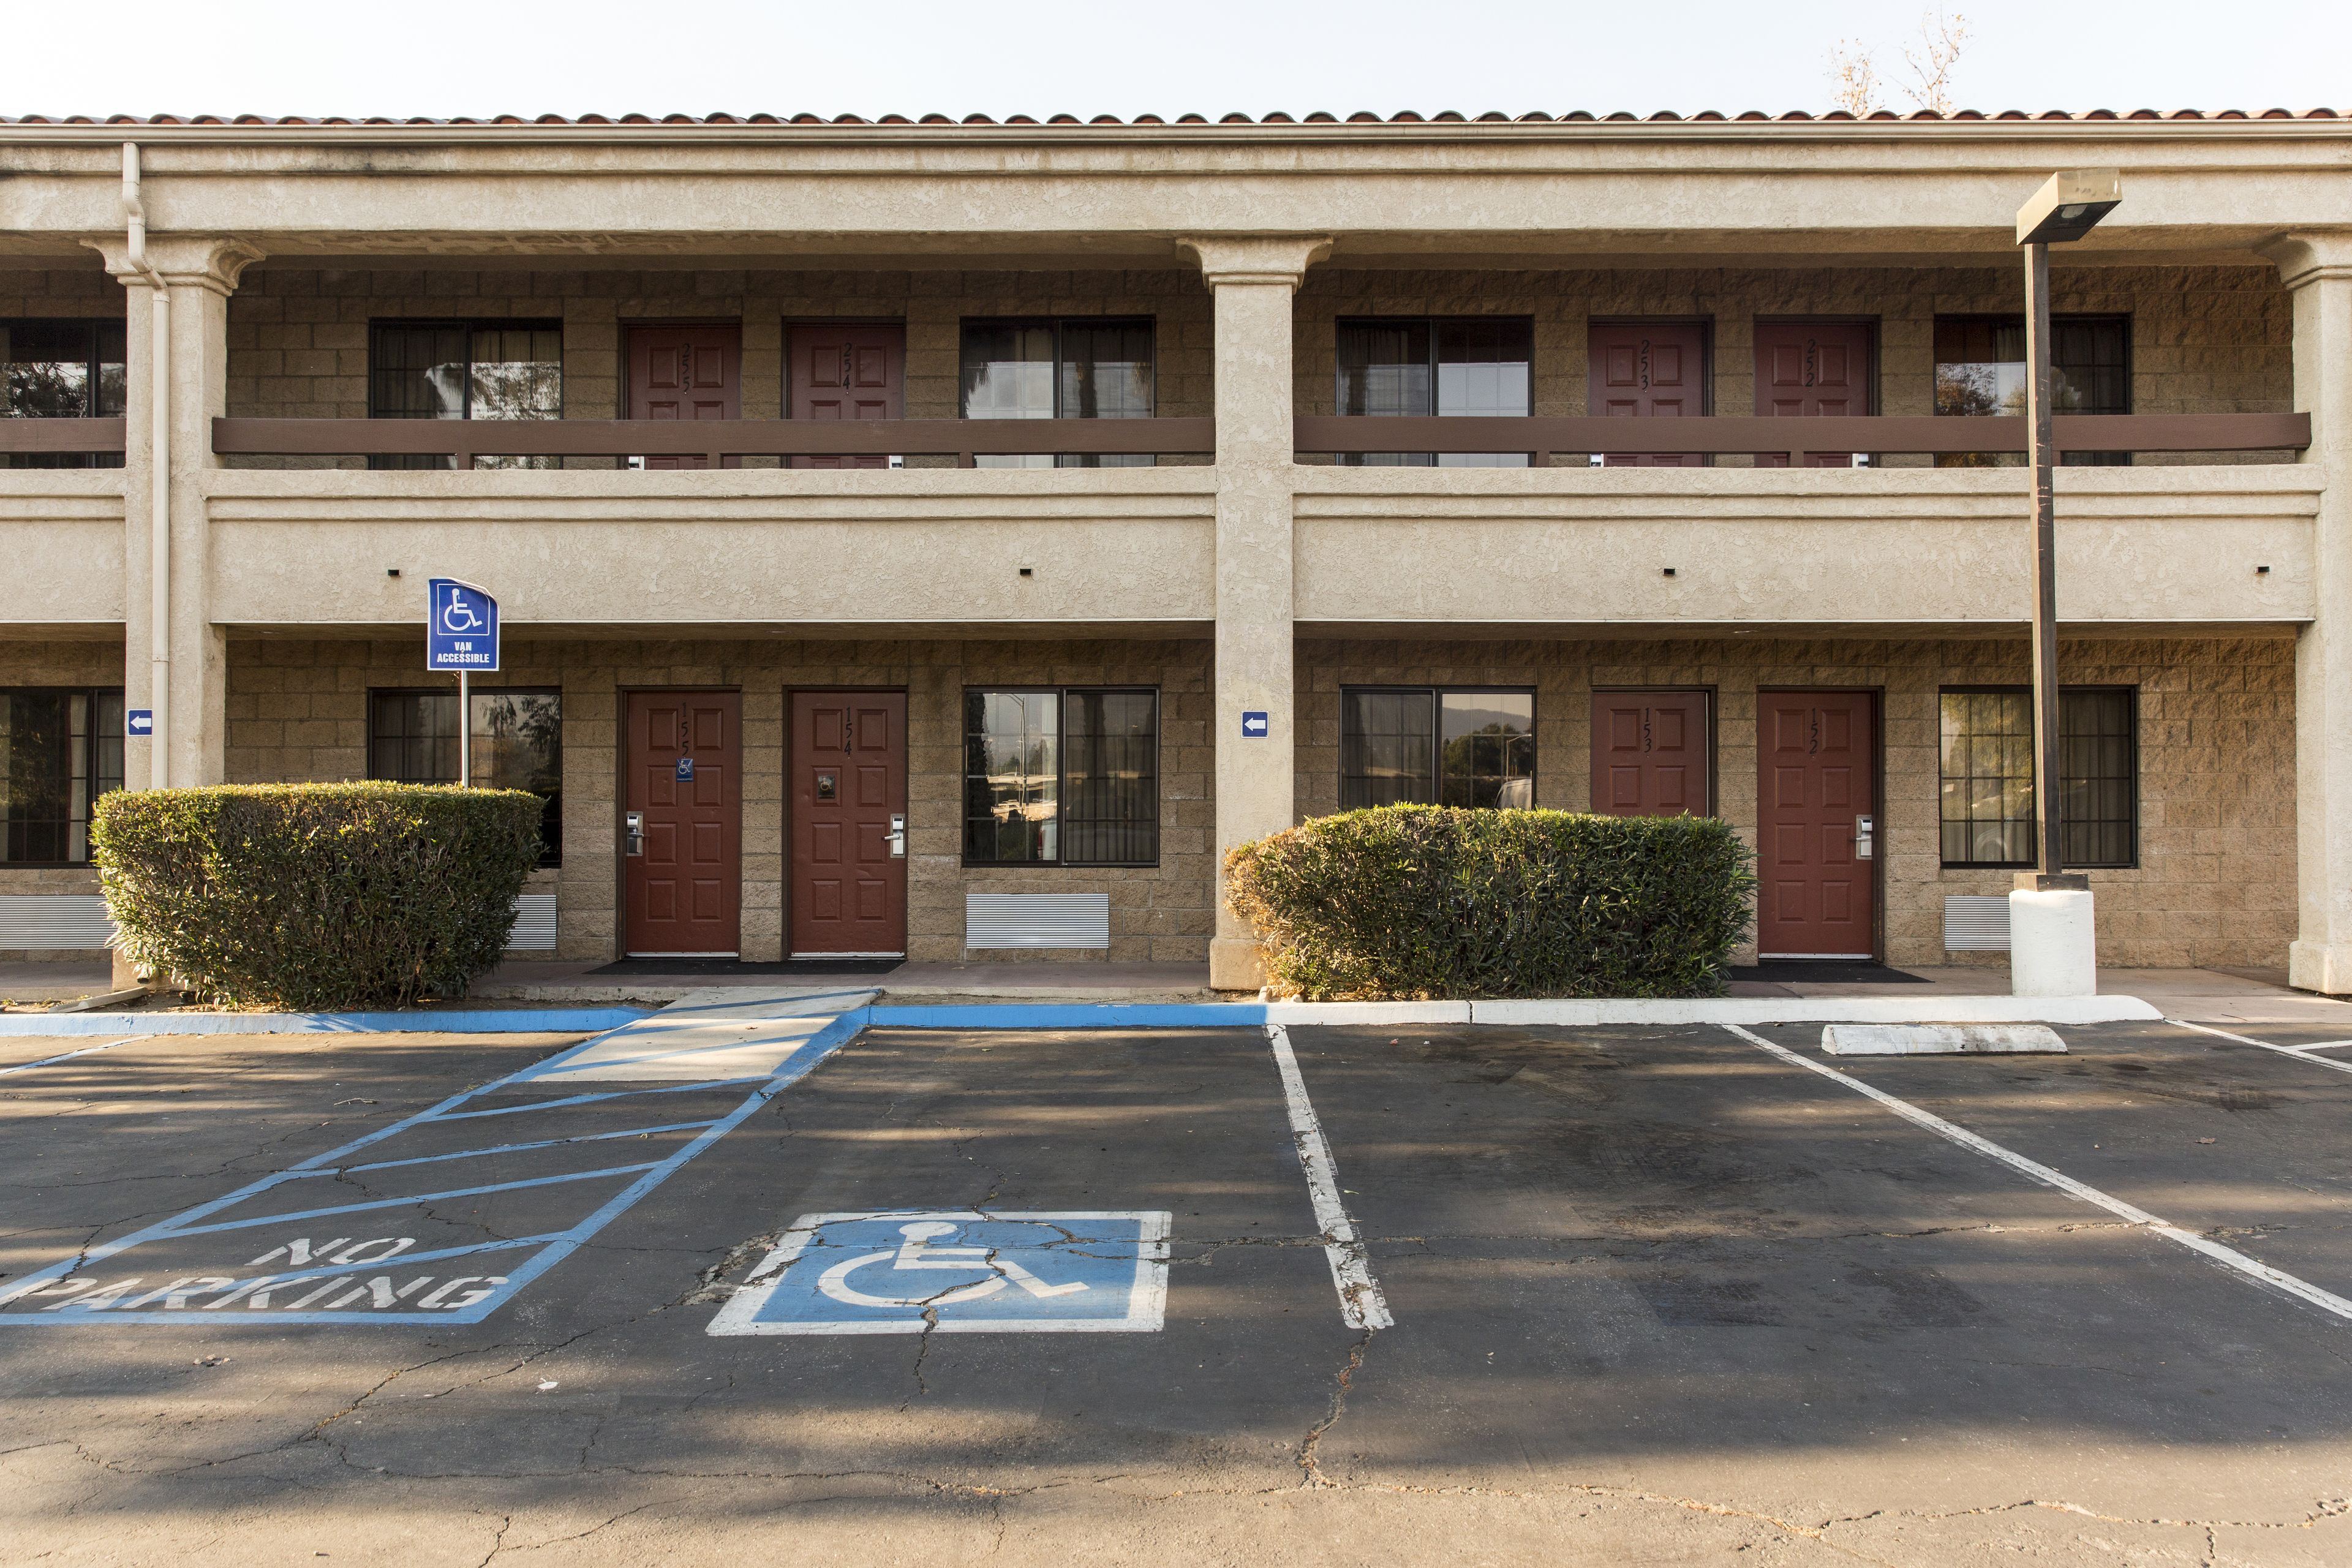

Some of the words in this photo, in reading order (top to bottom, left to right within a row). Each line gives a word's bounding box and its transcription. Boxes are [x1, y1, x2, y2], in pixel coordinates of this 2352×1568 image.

[842, 342, 852, 390] 254
[1641, 340, 1649, 390] 253
[1805, 339, 1815, 387] 252
[437, 653, 489, 663] ACCESSIBLE
[454, 642, 472, 651] VAN
[844, 706, 853, 755] 154
[1643, 707, 1652, 753] 153
[1809, 707, 1818, 755] 152
[245, 1237, 417, 1265] NO
[0, 1276, 510, 1310] PARKING
